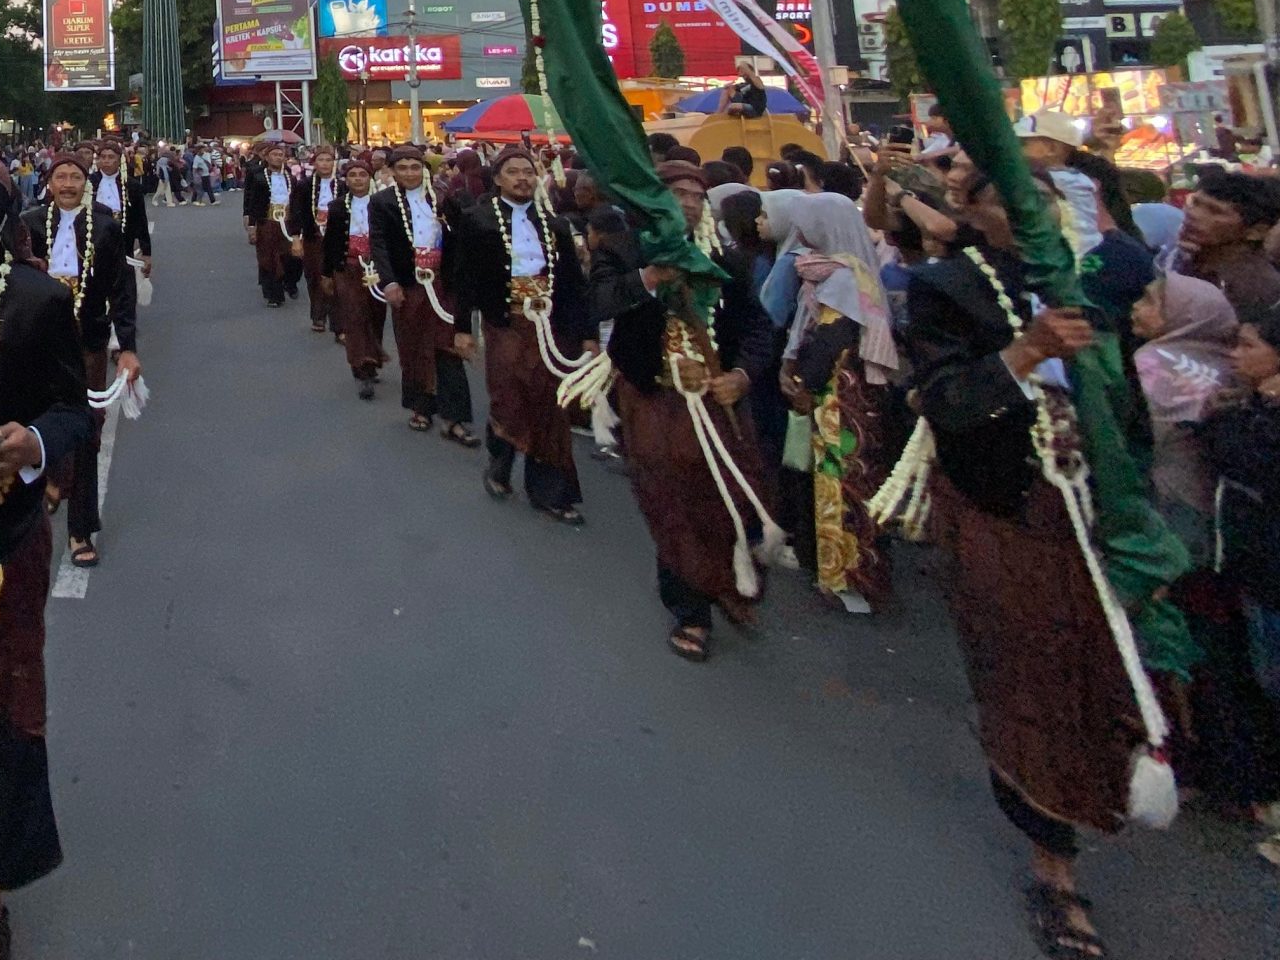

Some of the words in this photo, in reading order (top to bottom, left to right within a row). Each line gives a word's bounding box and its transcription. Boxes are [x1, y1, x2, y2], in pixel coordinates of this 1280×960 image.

[224, 19, 260, 35] PERTAMA
[225, 31, 251, 44] KRETEK
[256, 24, 283, 37] KAPSUL
[63, 36, 93, 45] KRETEK
[369, 45, 441, 62] kartka
